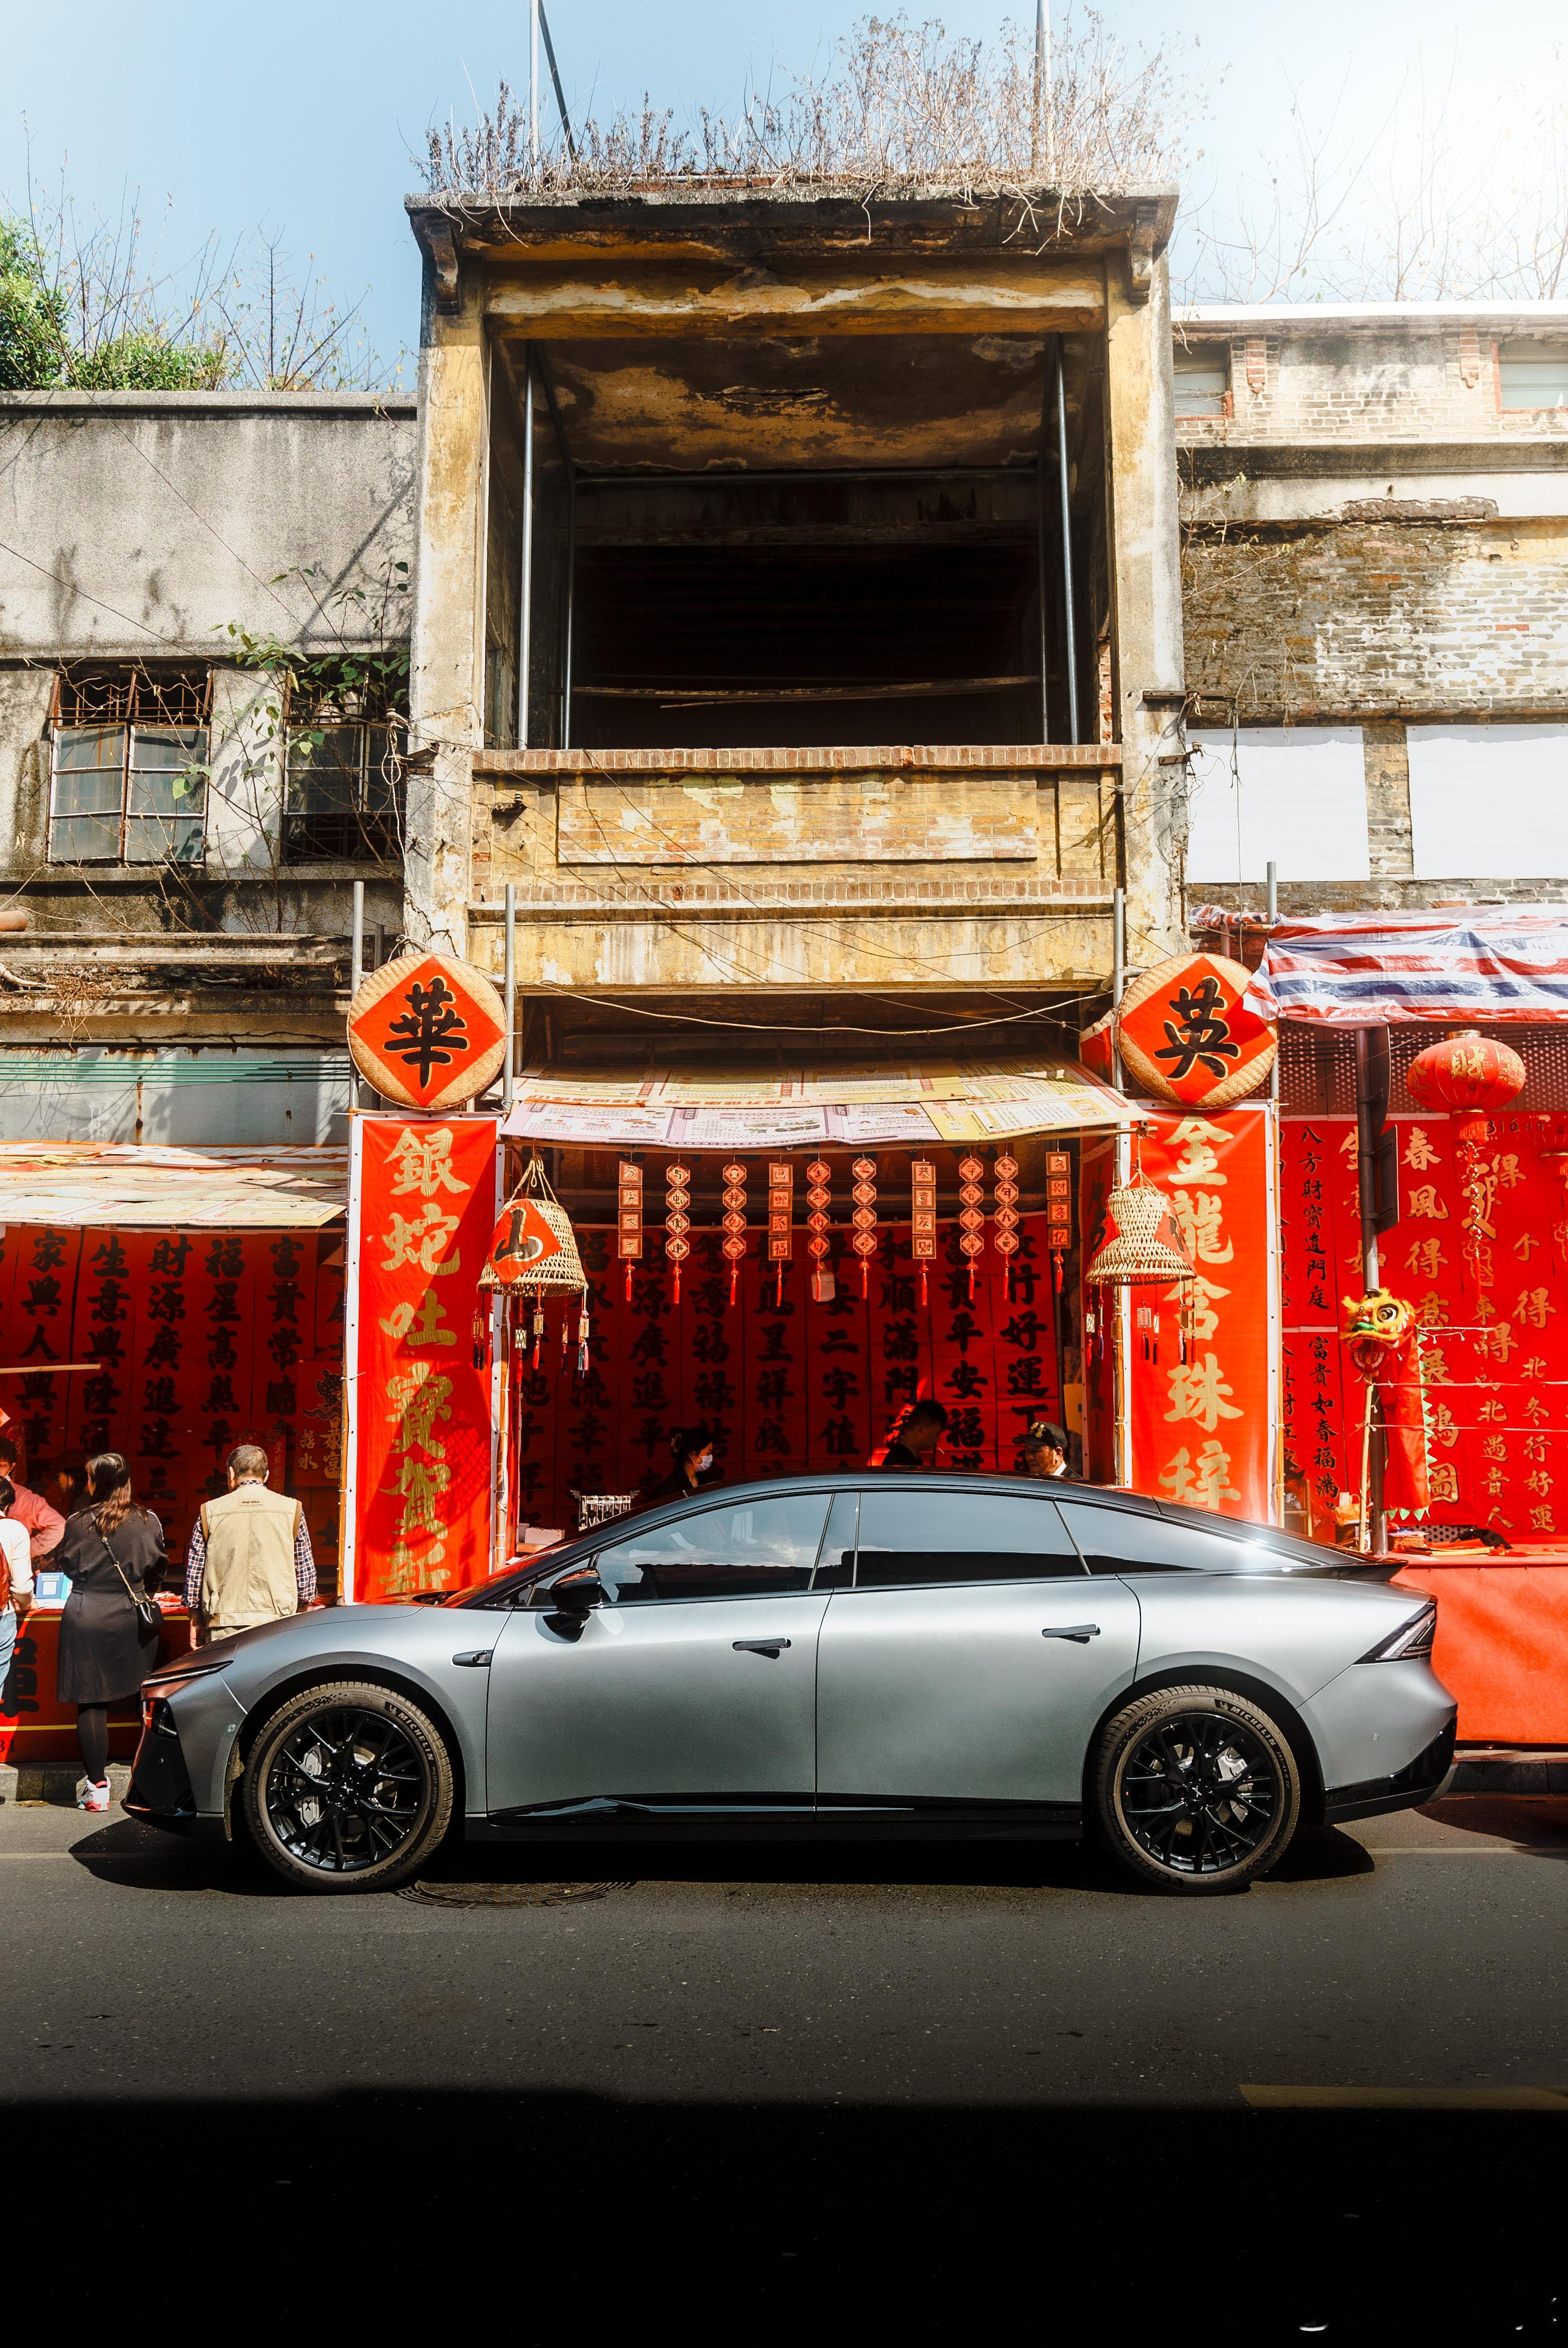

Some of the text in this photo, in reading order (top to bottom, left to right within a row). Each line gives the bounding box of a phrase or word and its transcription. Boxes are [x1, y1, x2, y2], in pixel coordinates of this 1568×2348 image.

[384, 977, 471, 1090] 華
[1153, 976, 1240, 1081] 英
[493, 1207, 544, 1262] 山
[917, 1166, 932, 1254] 恭喜发财
[818, 1230, 860, 1466] 平安二字值
[1310, 1335, 1341, 1518] 富貴如春福滿
[398, 1712, 434, 1760] MICHELIN
[1231, 1706, 1277, 1745] MICHELIN
